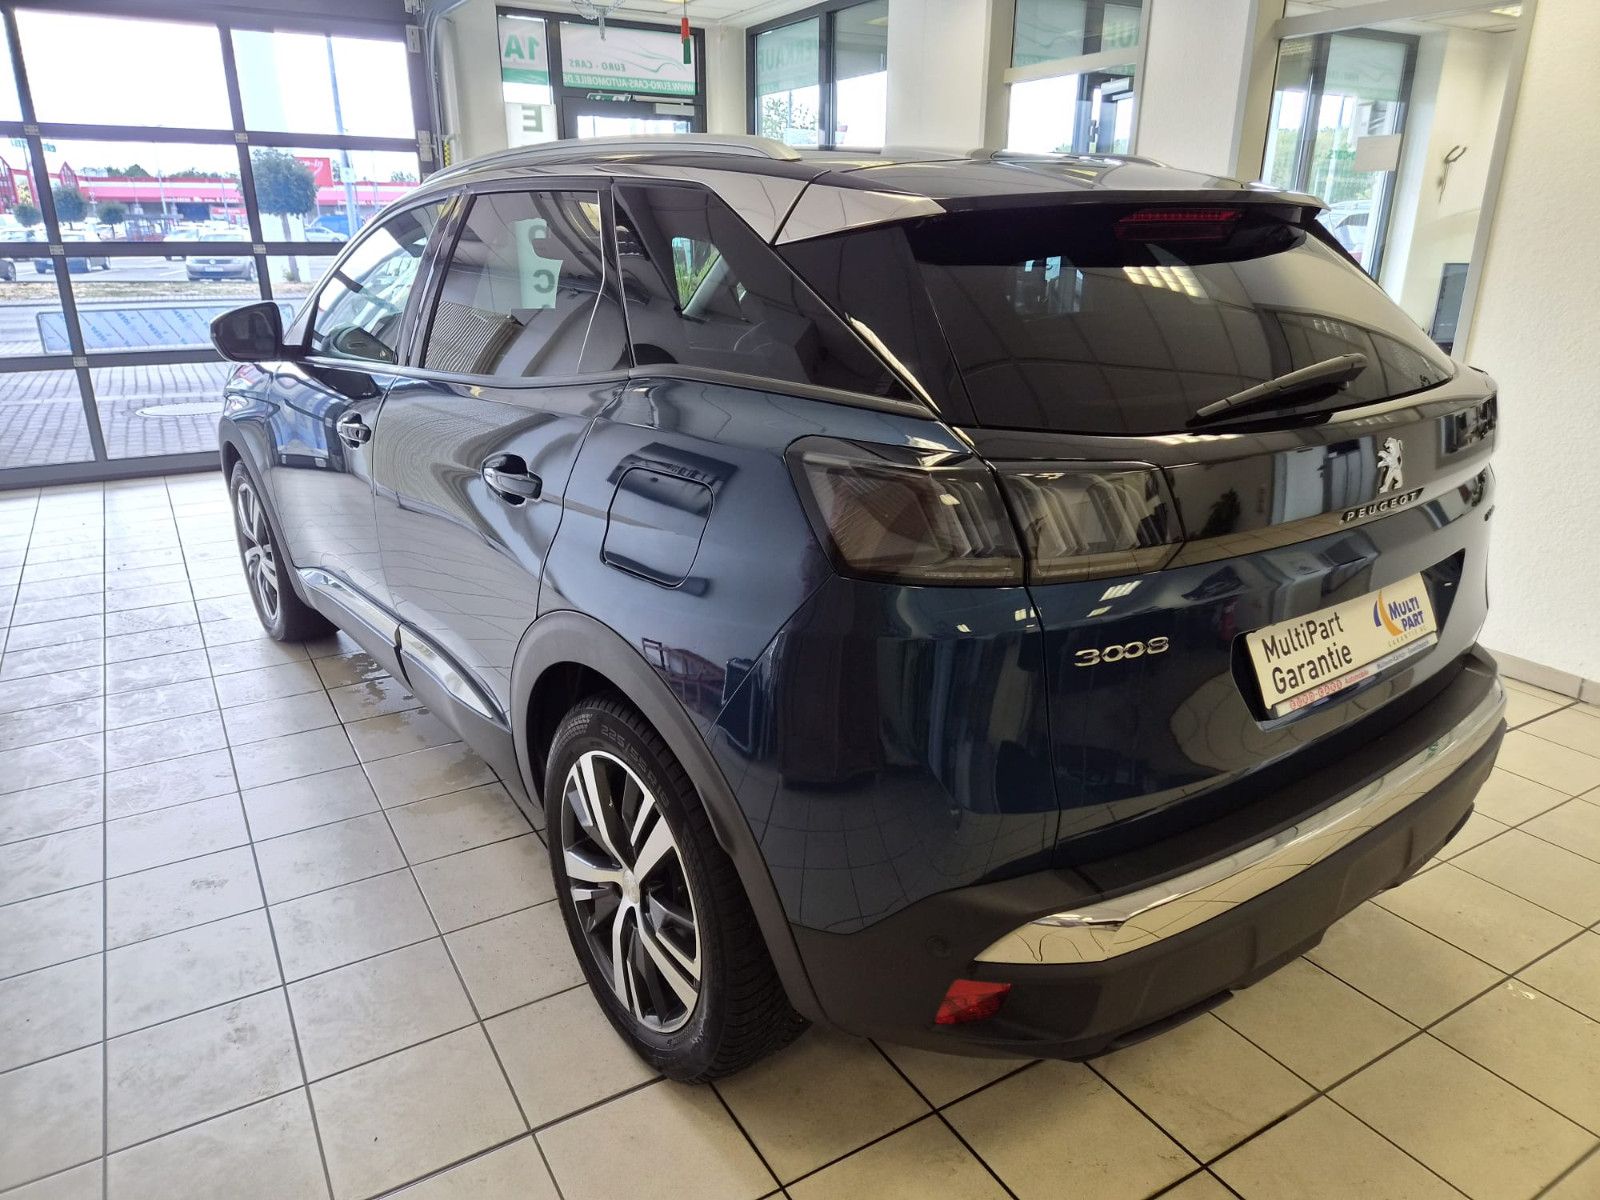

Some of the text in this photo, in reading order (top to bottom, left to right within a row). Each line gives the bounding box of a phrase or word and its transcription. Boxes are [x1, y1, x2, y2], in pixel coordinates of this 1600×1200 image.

[1345, 492, 1418, 523] PEUGEOT
[1388, 597, 1420, 620] MULTI
[1401, 611, 1425, 632] PART
[1074, 636, 1170, 667] 3008
[1262, 612, 1344, 663] MultiPart
[1272, 643, 1353, 694] Garantie
